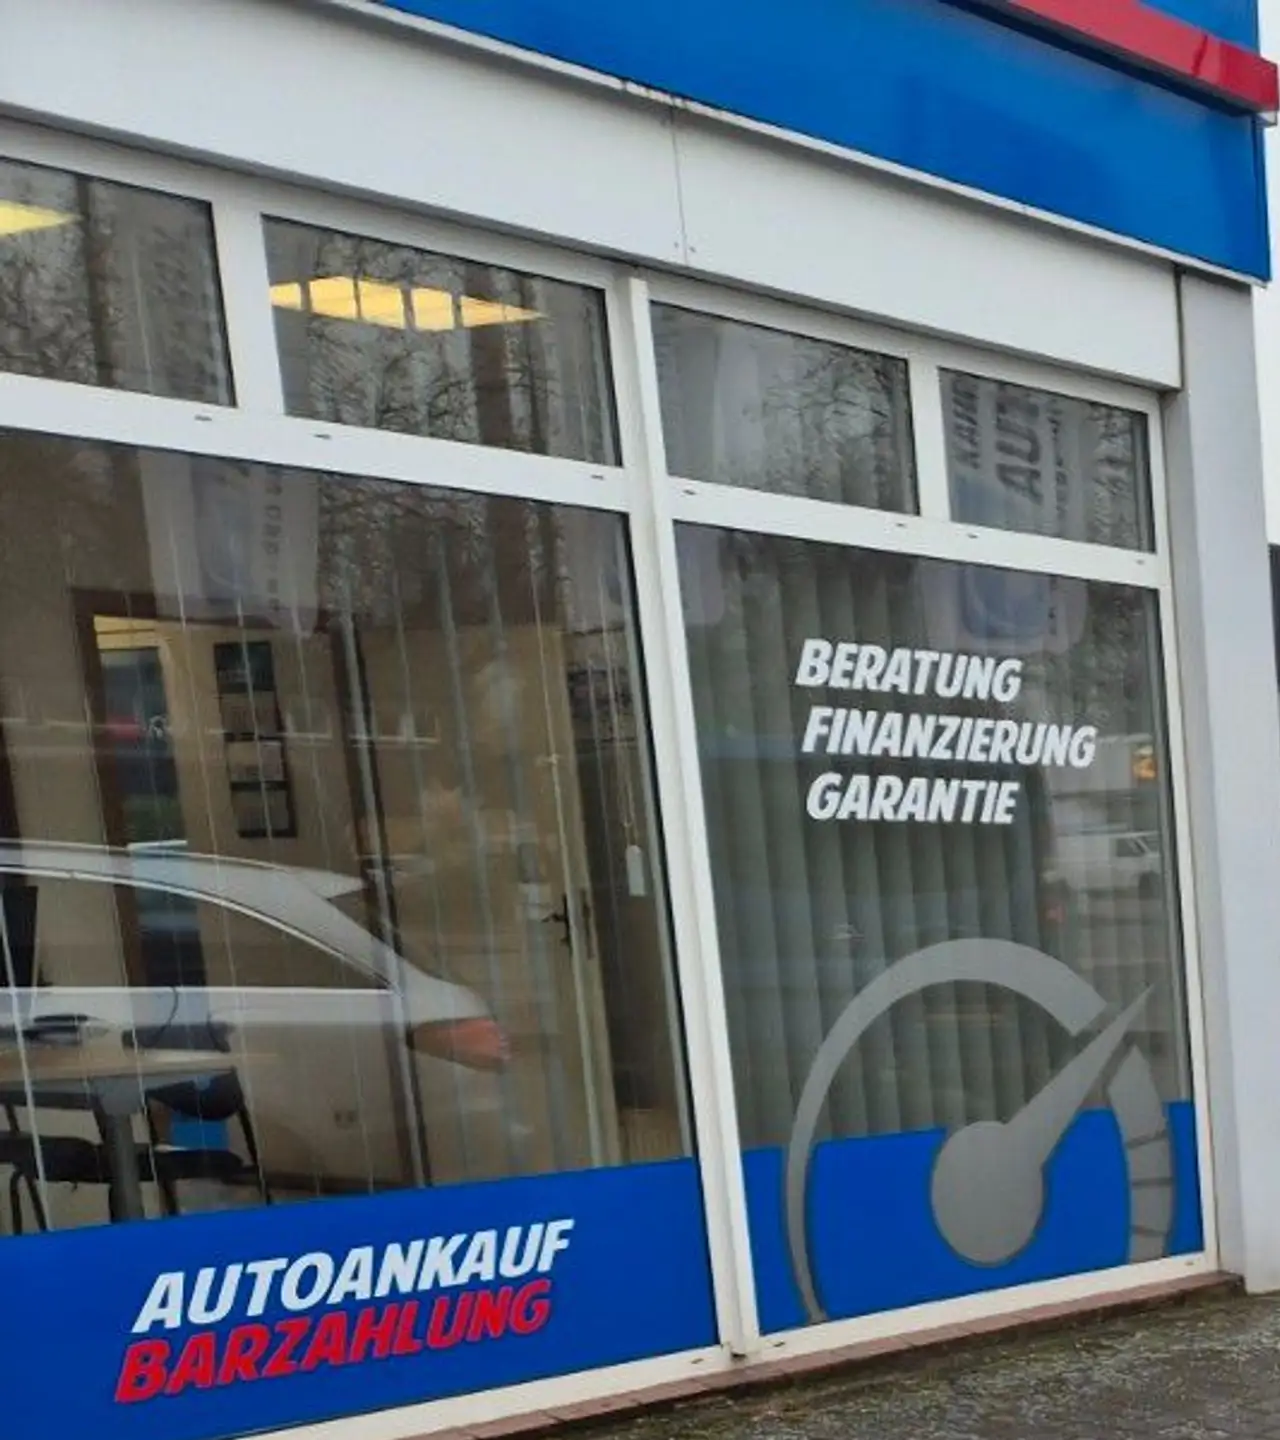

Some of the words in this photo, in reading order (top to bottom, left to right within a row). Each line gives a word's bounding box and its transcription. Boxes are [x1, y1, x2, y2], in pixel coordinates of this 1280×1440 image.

[796, 639, 1022, 703] BERATUNG
[802, 707, 1098, 768] FINANZIERUNG
[805, 772, 1020, 824] GARANTIE
[131, 1218, 575, 1334] AUTOANKAUF
[114, 1280, 551, 1404] BARZAHLUNG
